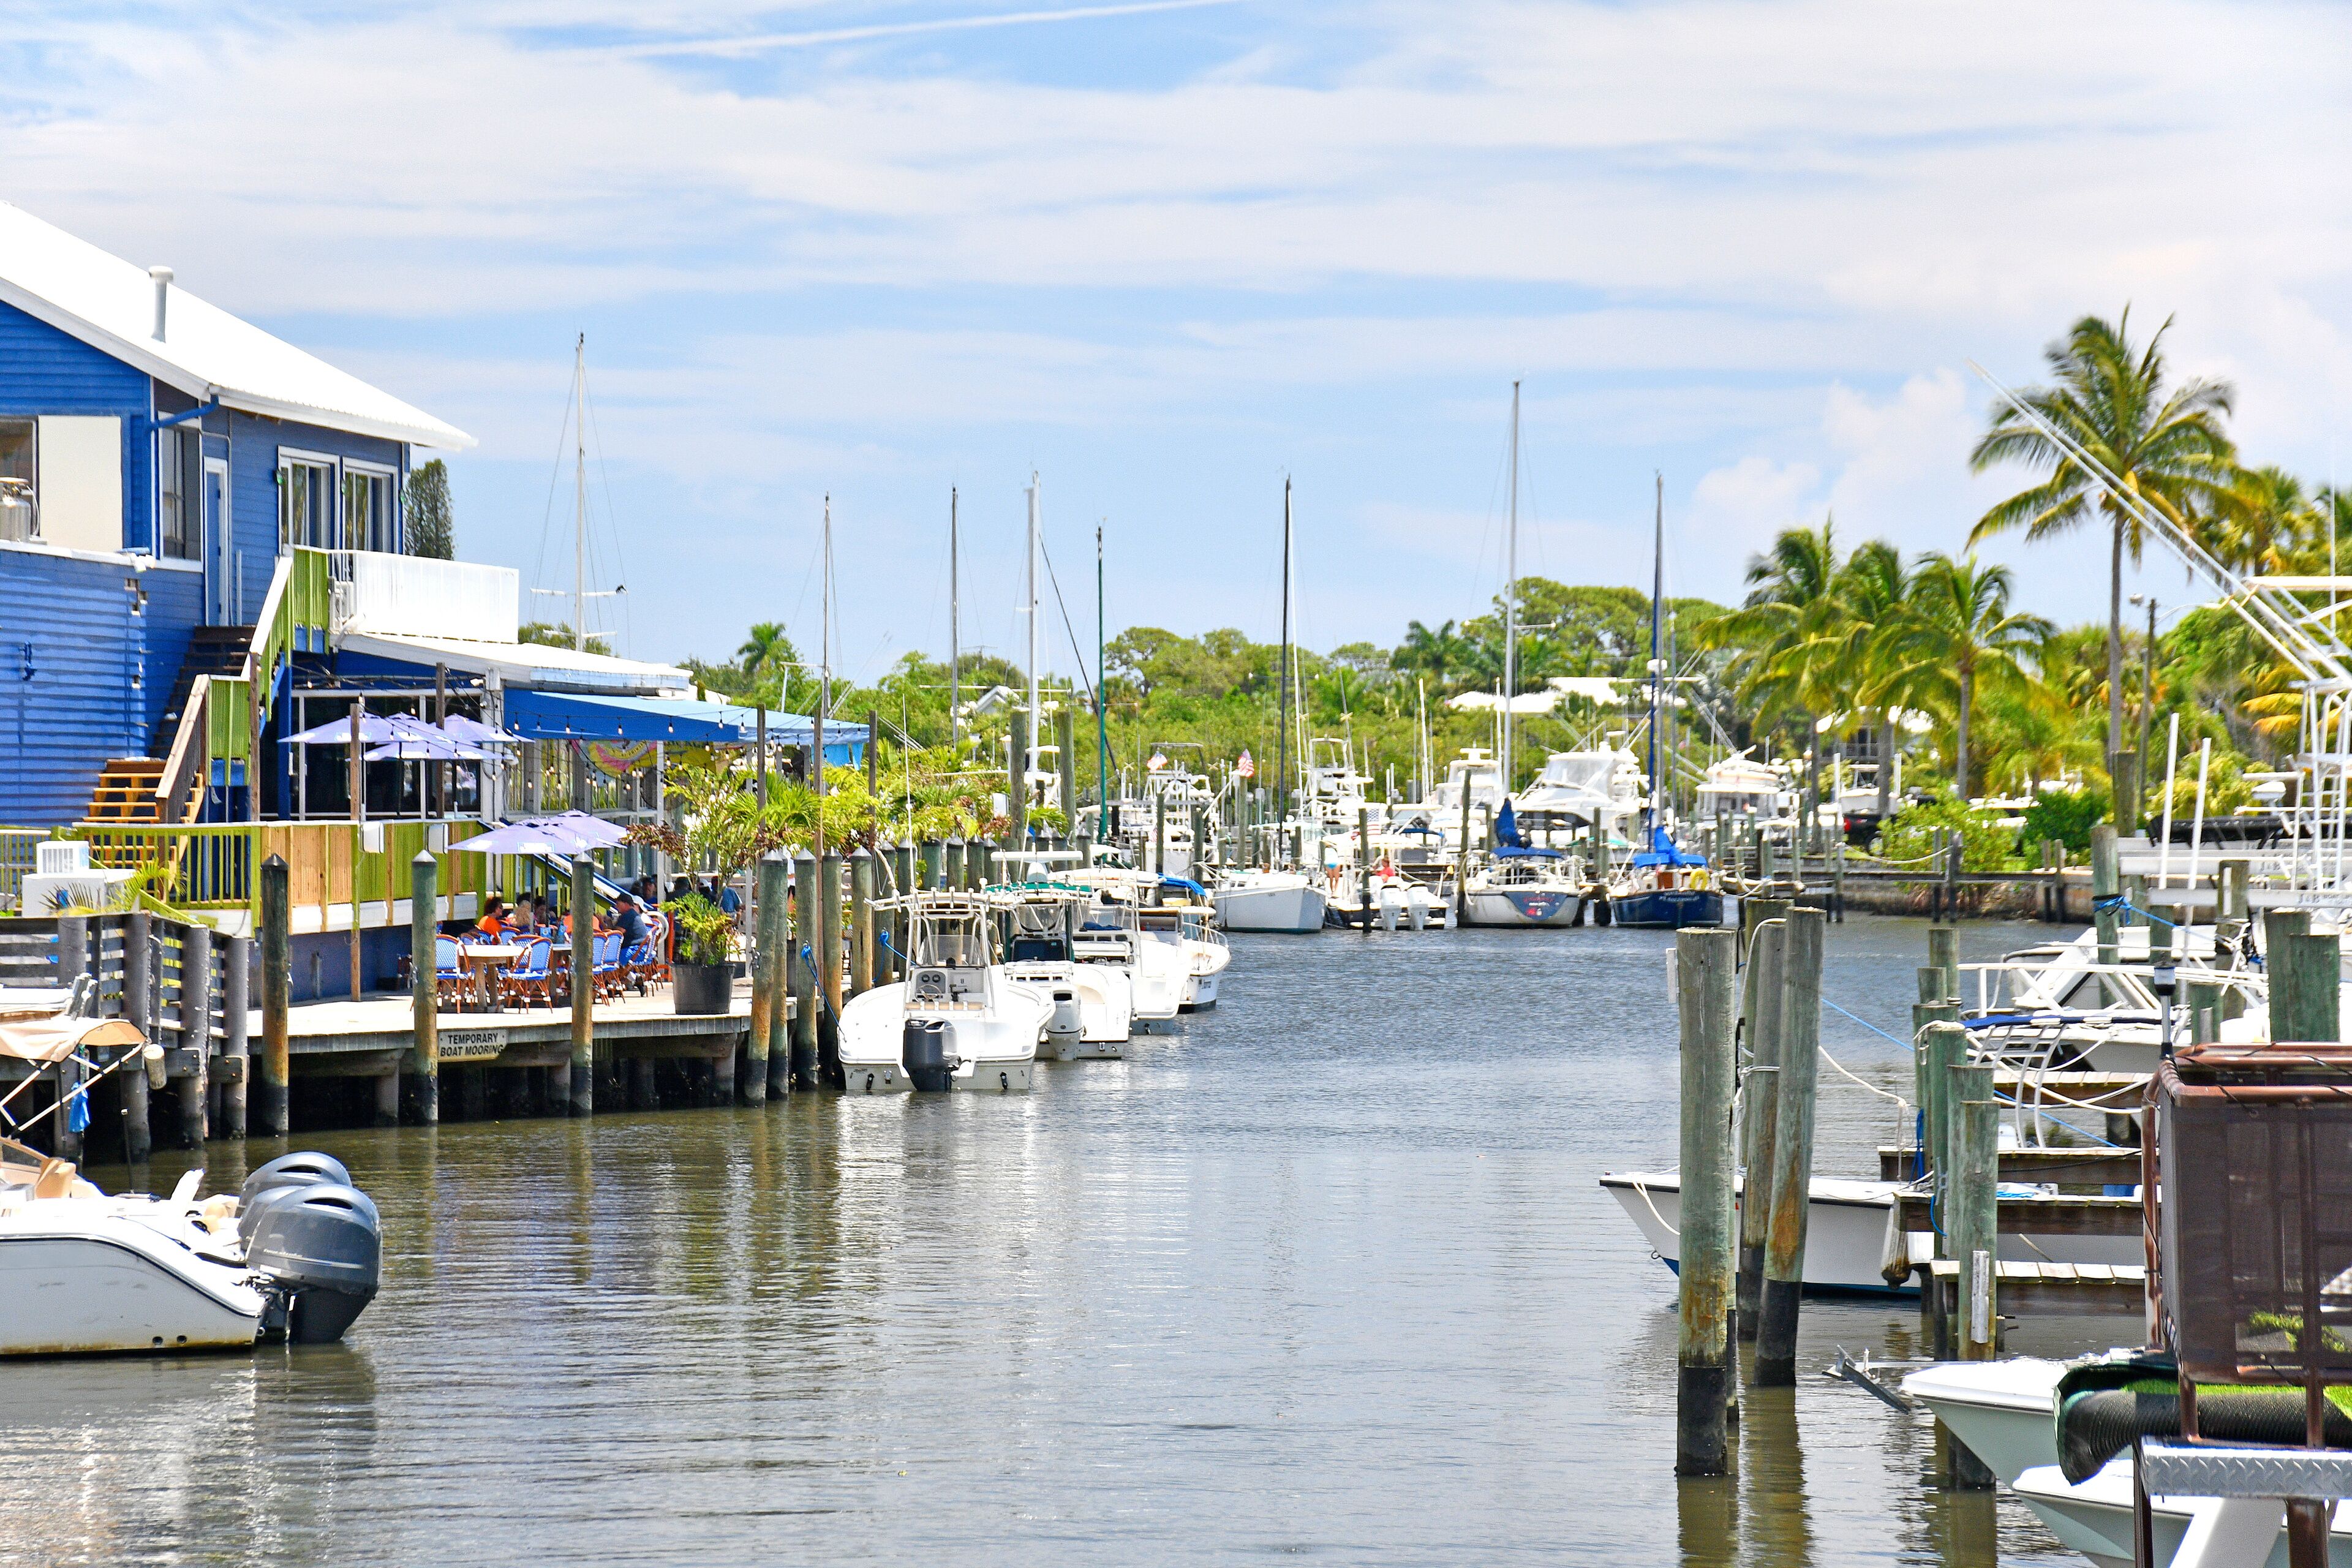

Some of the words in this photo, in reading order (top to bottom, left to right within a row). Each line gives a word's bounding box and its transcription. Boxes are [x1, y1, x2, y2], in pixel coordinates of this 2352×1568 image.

[448, 1033, 498, 1044] TEMPORARY
[440, 1047, 462, 1057] BOAT
[464, 1044, 504, 1056] MOORING
